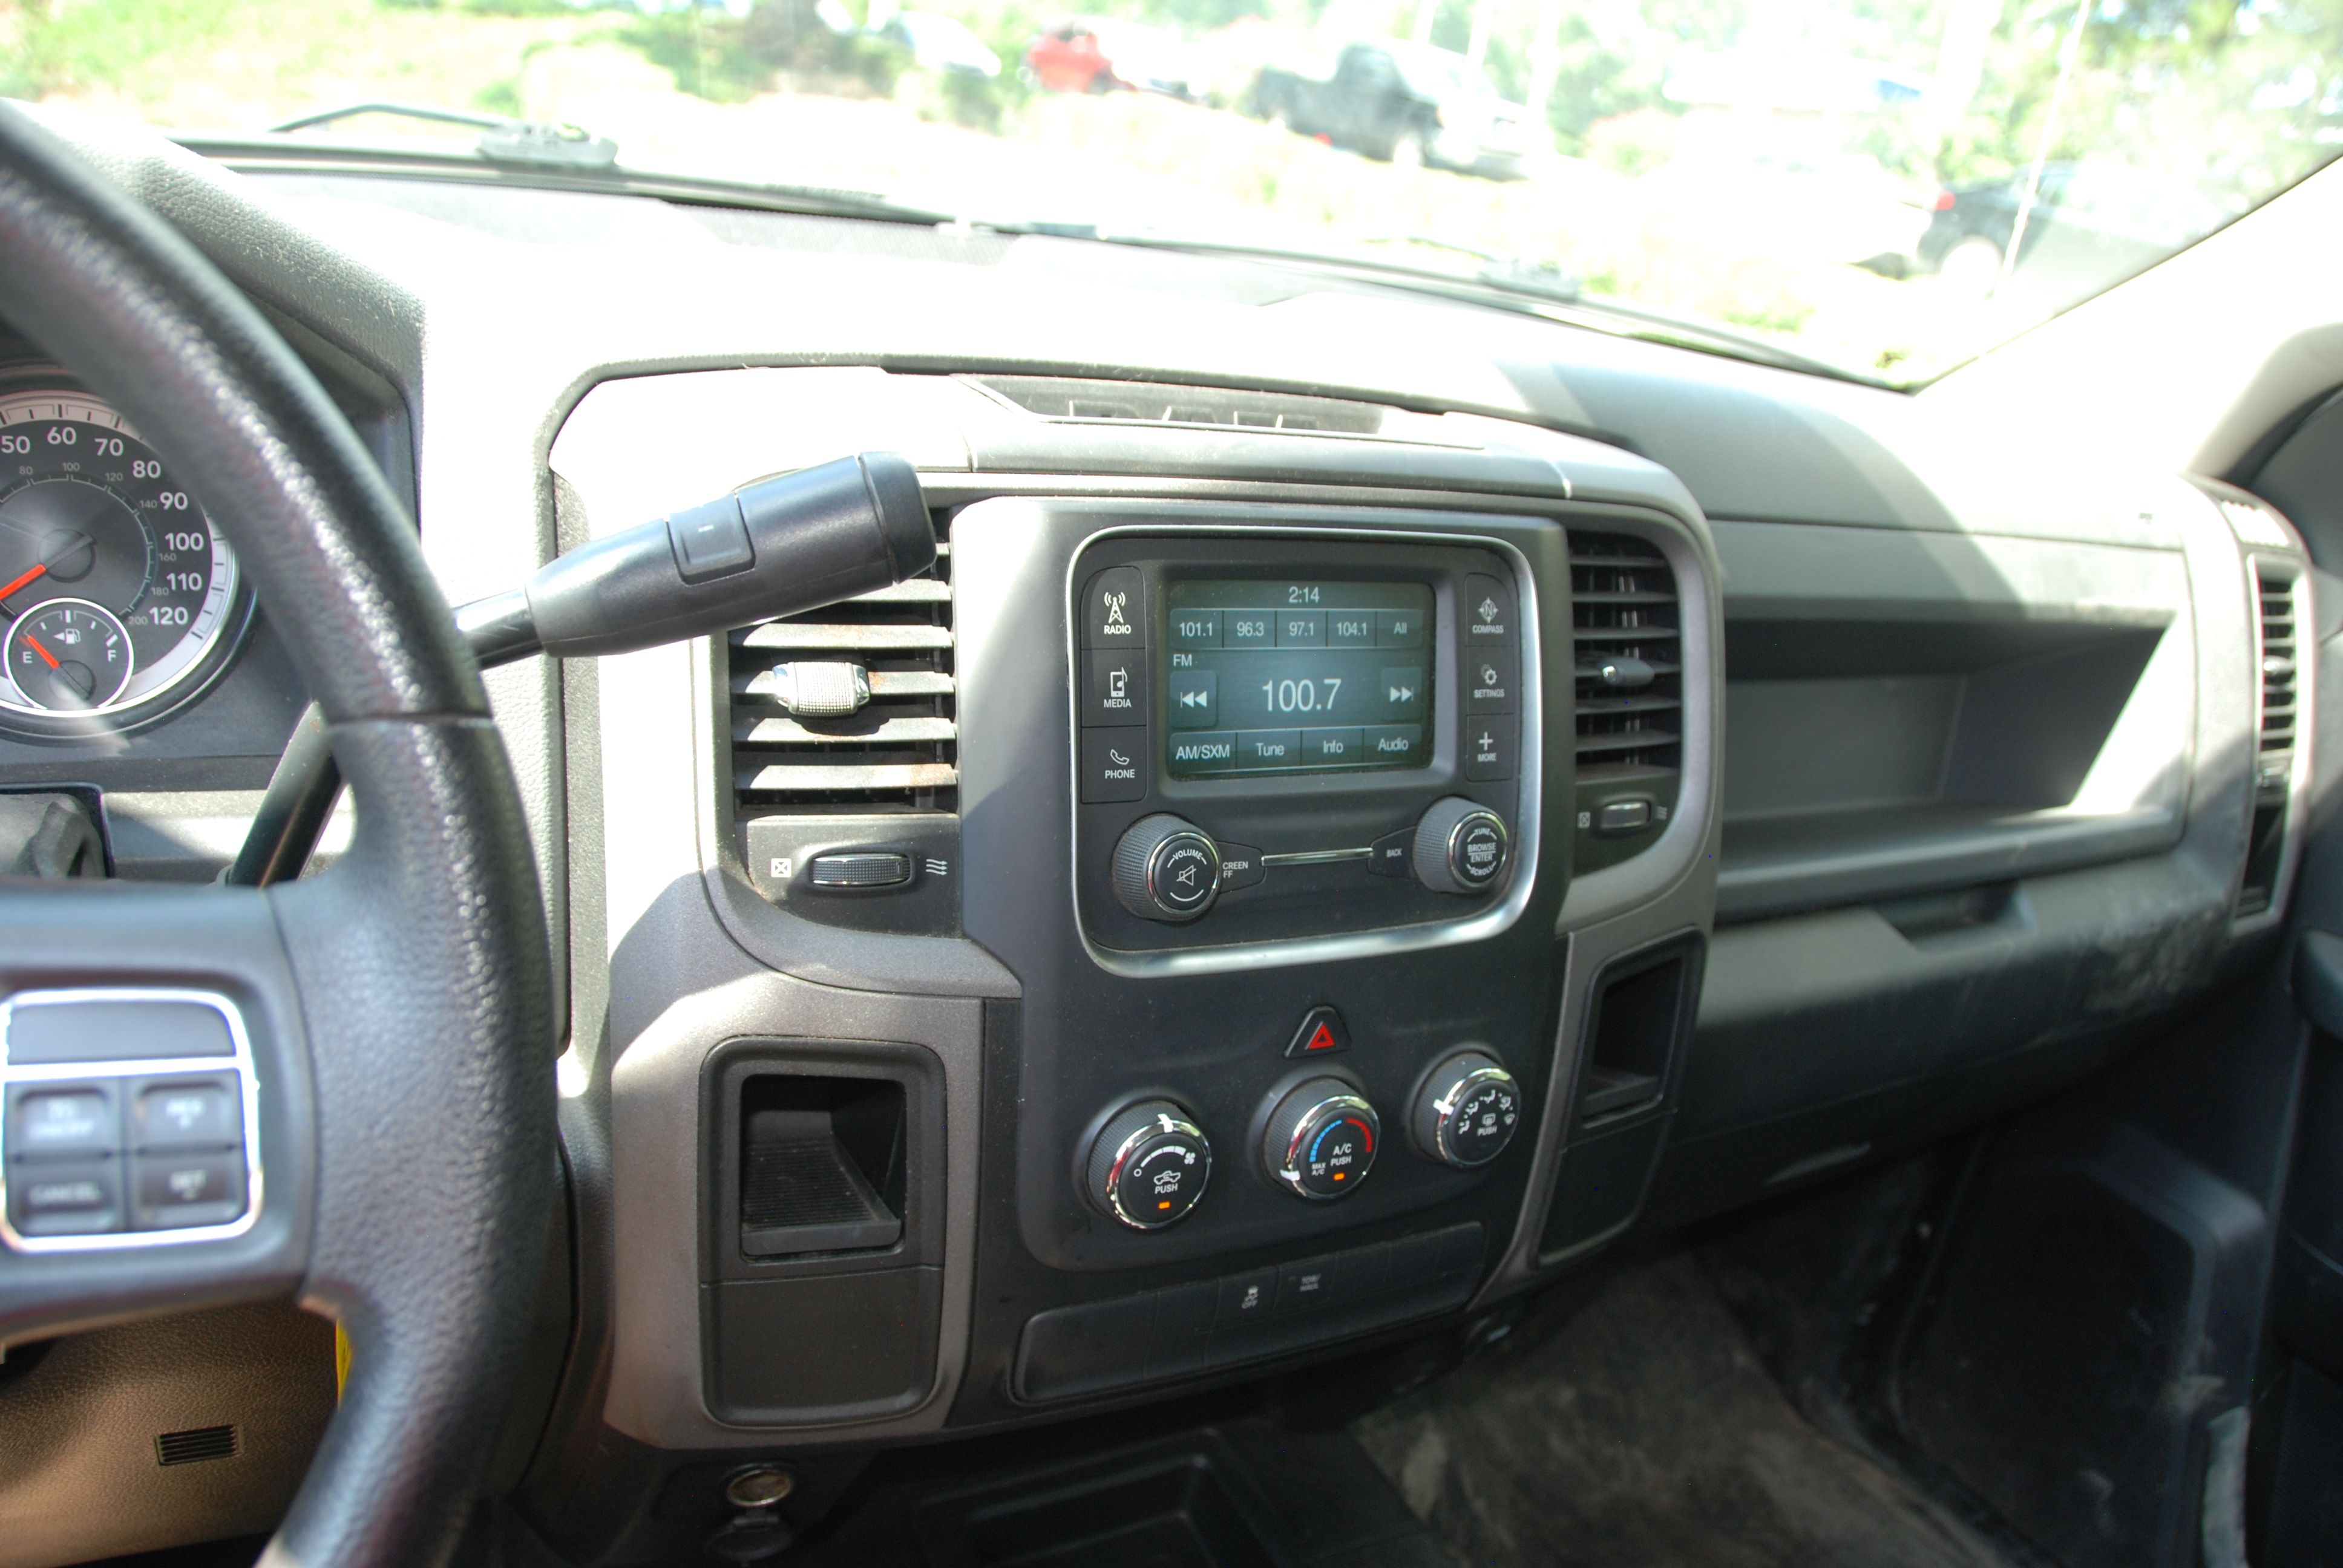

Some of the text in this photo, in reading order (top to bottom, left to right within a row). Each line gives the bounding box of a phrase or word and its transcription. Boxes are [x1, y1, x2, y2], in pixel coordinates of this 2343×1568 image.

[47, 426, 77, 445] 60
[1, 435, 31, 454] 50
[94, 437, 124, 456] 70
[19, 466, 33, 475] 80
[62, 462, 80, 471] 100
[133, 460, 162, 479] 80
[105, 472, 123, 482] 120
[139, 500, 157, 509] 140
[159, 492, 188, 510] 90
[165, 532, 205, 551] 100
[159, 553, 177, 562] 160
[166, 572, 203, 591] 110
[151, 587, 169, 596] 180
[1288, 586, 1320, 604] 2:14
[128, 616, 148, 626] 200
[149, 607, 189, 626] 120
[1104, 624, 1132, 635] RADIO
[1179, 622, 1213, 637] 101.1
[1236, 622, 1264, 637] 96.3
[1289, 622, 1314, 636] 97.1
[1336, 622, 1368, 636] 104.1
[1394, 621, 1407, 634] All
[1472, 624, 1504, 634] COMPASS
[23, 651, 33, 664] E
[107, 649, 117, 662] F
[1173, 654, 1193, 667] FM
[1262, 678, 1342, 712] 100.7
[1473, 688, 1505, 698] SETTINGS
[1103, 698, 1132, 708] MEDIA
[1256, 742, 1285, 757] Tune
[1323, 740, 1343, 754] Info
[1378, 737, 1409, 751] Audio
[1176, 744, 1230, 760] AM/SXM
[1477, 753, 1497, 762] MORE
[1105, 769, 1135, 779] PHONE
[1474, 827, 1491, 836] TUNE
[1386, 848, 1403, 858] BACK
[1467, 842, 1496, 852] BROWSE
[1173, 848, 1203, 860] VOLUME
[1470, 853, 1493, 863] ENTER
[1222, 861, 1249, 870] CREEN
[1470, 866, 1493, 876] SCROLL
[1223, 870, 1233, 878] FF
[1476, 1125, 1498, 1136] PUSH
[1332, 1143, 1352, 1156] A/C
[1311, 1161, 1326, 1170] MAX
[1330, 1155, 1352, 1167] PUSH
[1311, 1168, 1325, 1176] A/C
[1155, 1183, 1178, 1194] PUSH
